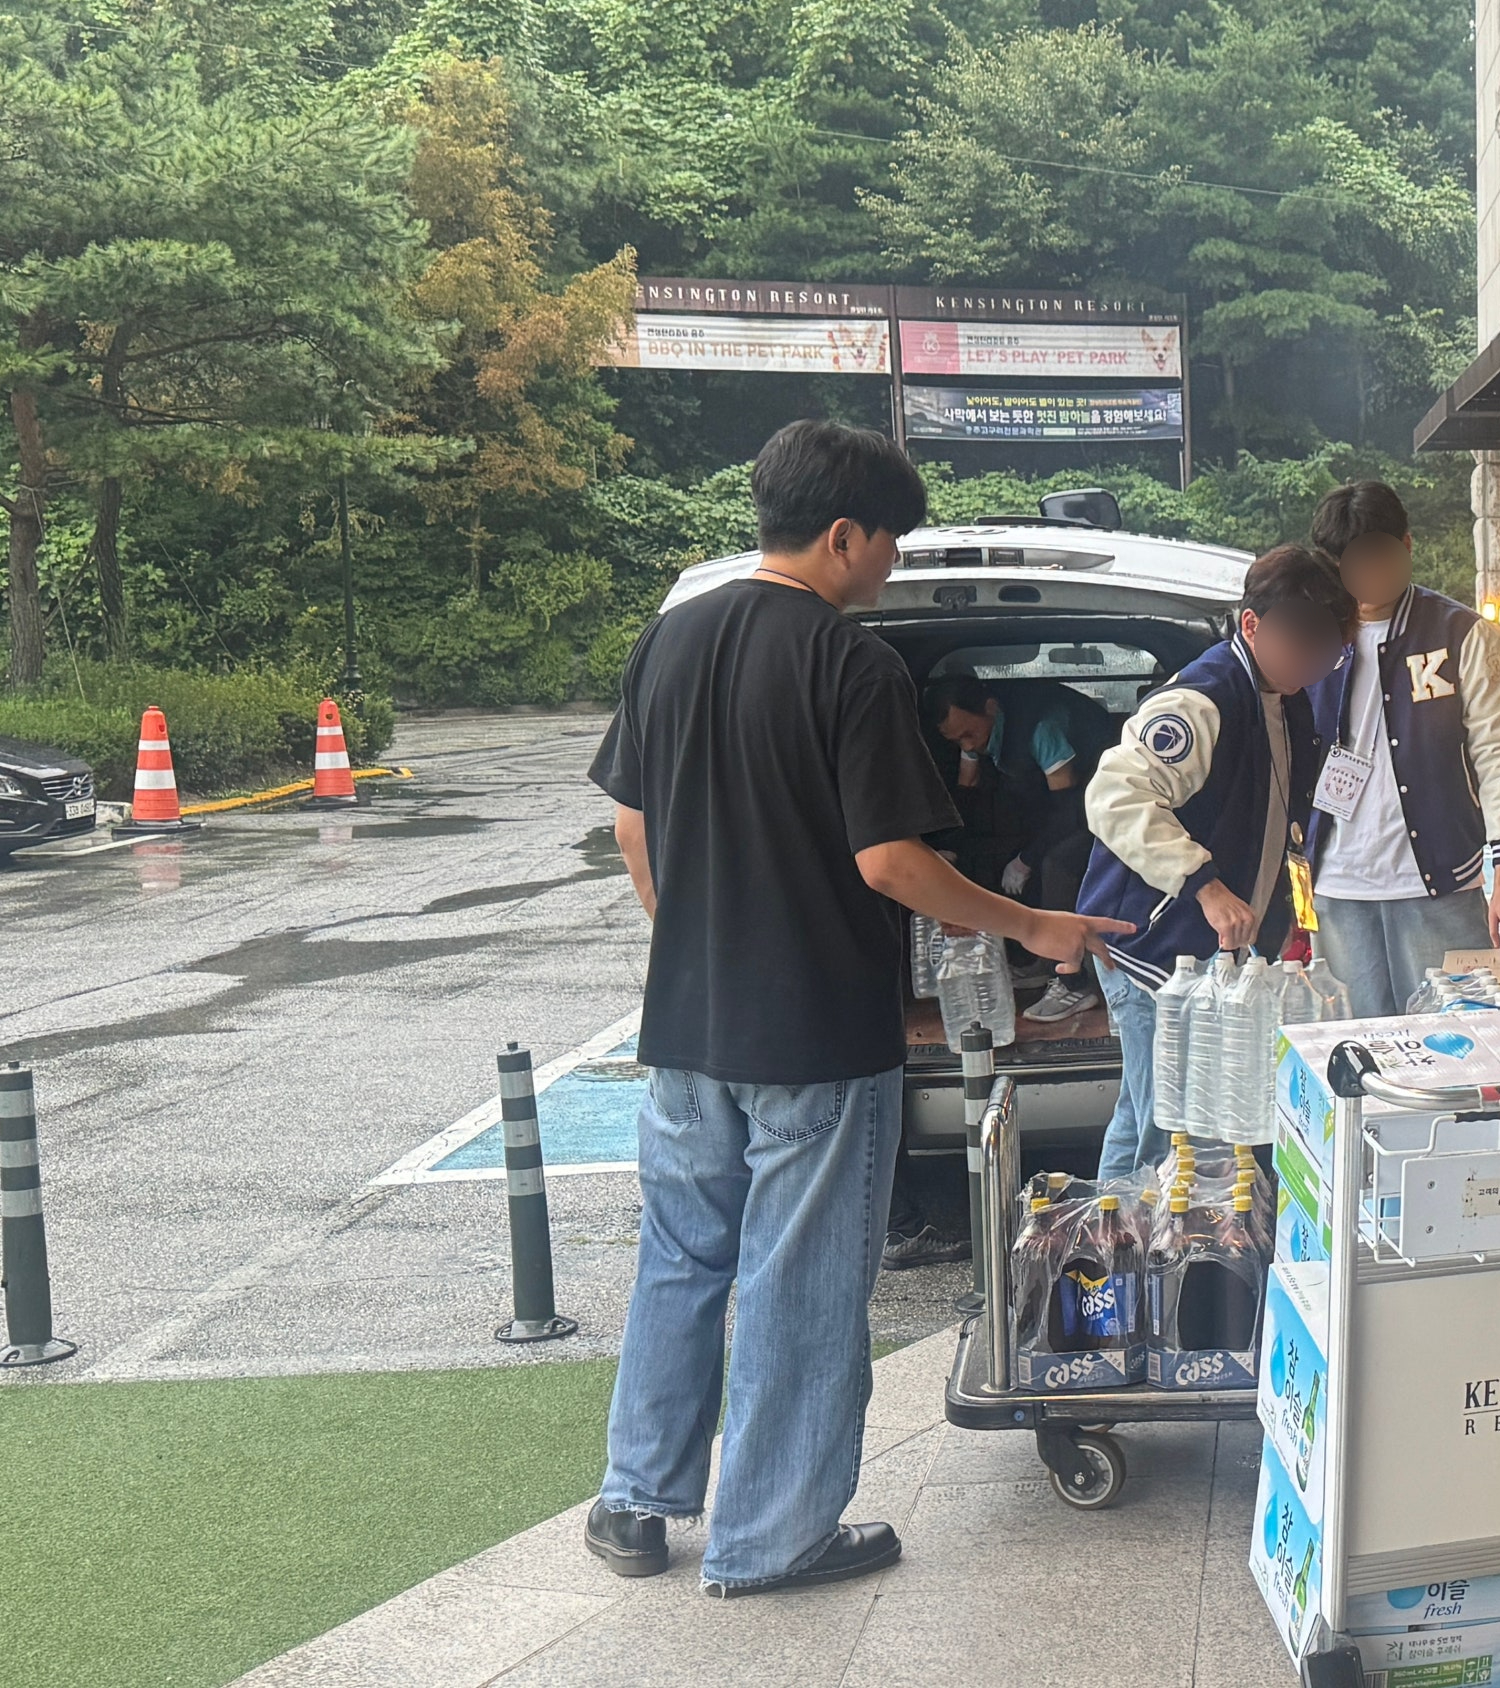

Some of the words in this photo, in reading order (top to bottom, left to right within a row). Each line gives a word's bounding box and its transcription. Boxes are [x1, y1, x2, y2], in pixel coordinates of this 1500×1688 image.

[635, 285, 757, 305] ENSINGTON
[770, 291, 850, 305] RESORT
[936, 296, 1062, 314] KENSINGTON
[648, 341, 683, 357] BBQ
[688, 342, 705, 356] IN
[710, 342, 742, 357] THE
[747, 343, 775, 358] PET
[782, 345, 823, 360] PARK
[967, 349, 1007, 364] LET'S
[1012, 351, 1047, 364] PLAY
[944, 408, 987, 424] 사막에서
[989, 409, 1010, 423] 보는
[1012, 409, 1033, 424] 듯한
[1036, 409, 1057, 424] 멋진
[1059, 410, 1101, 424] 밤하늘을
[1103, 408, 1167, 424] 경험해보세요!
[1406, 648, 1455, 703] K
[1287, 1338, 1299, 1379] 참
[1284, 1378, 1302, 1428] 이슬
[1281, 1502, 1294, 1545] 참
[1276, 1542, 1294, 1595] 이슬
[1427, 1579, 1470, 1601] 이슬
[1424, 1601, 1462, 1620] fresh
